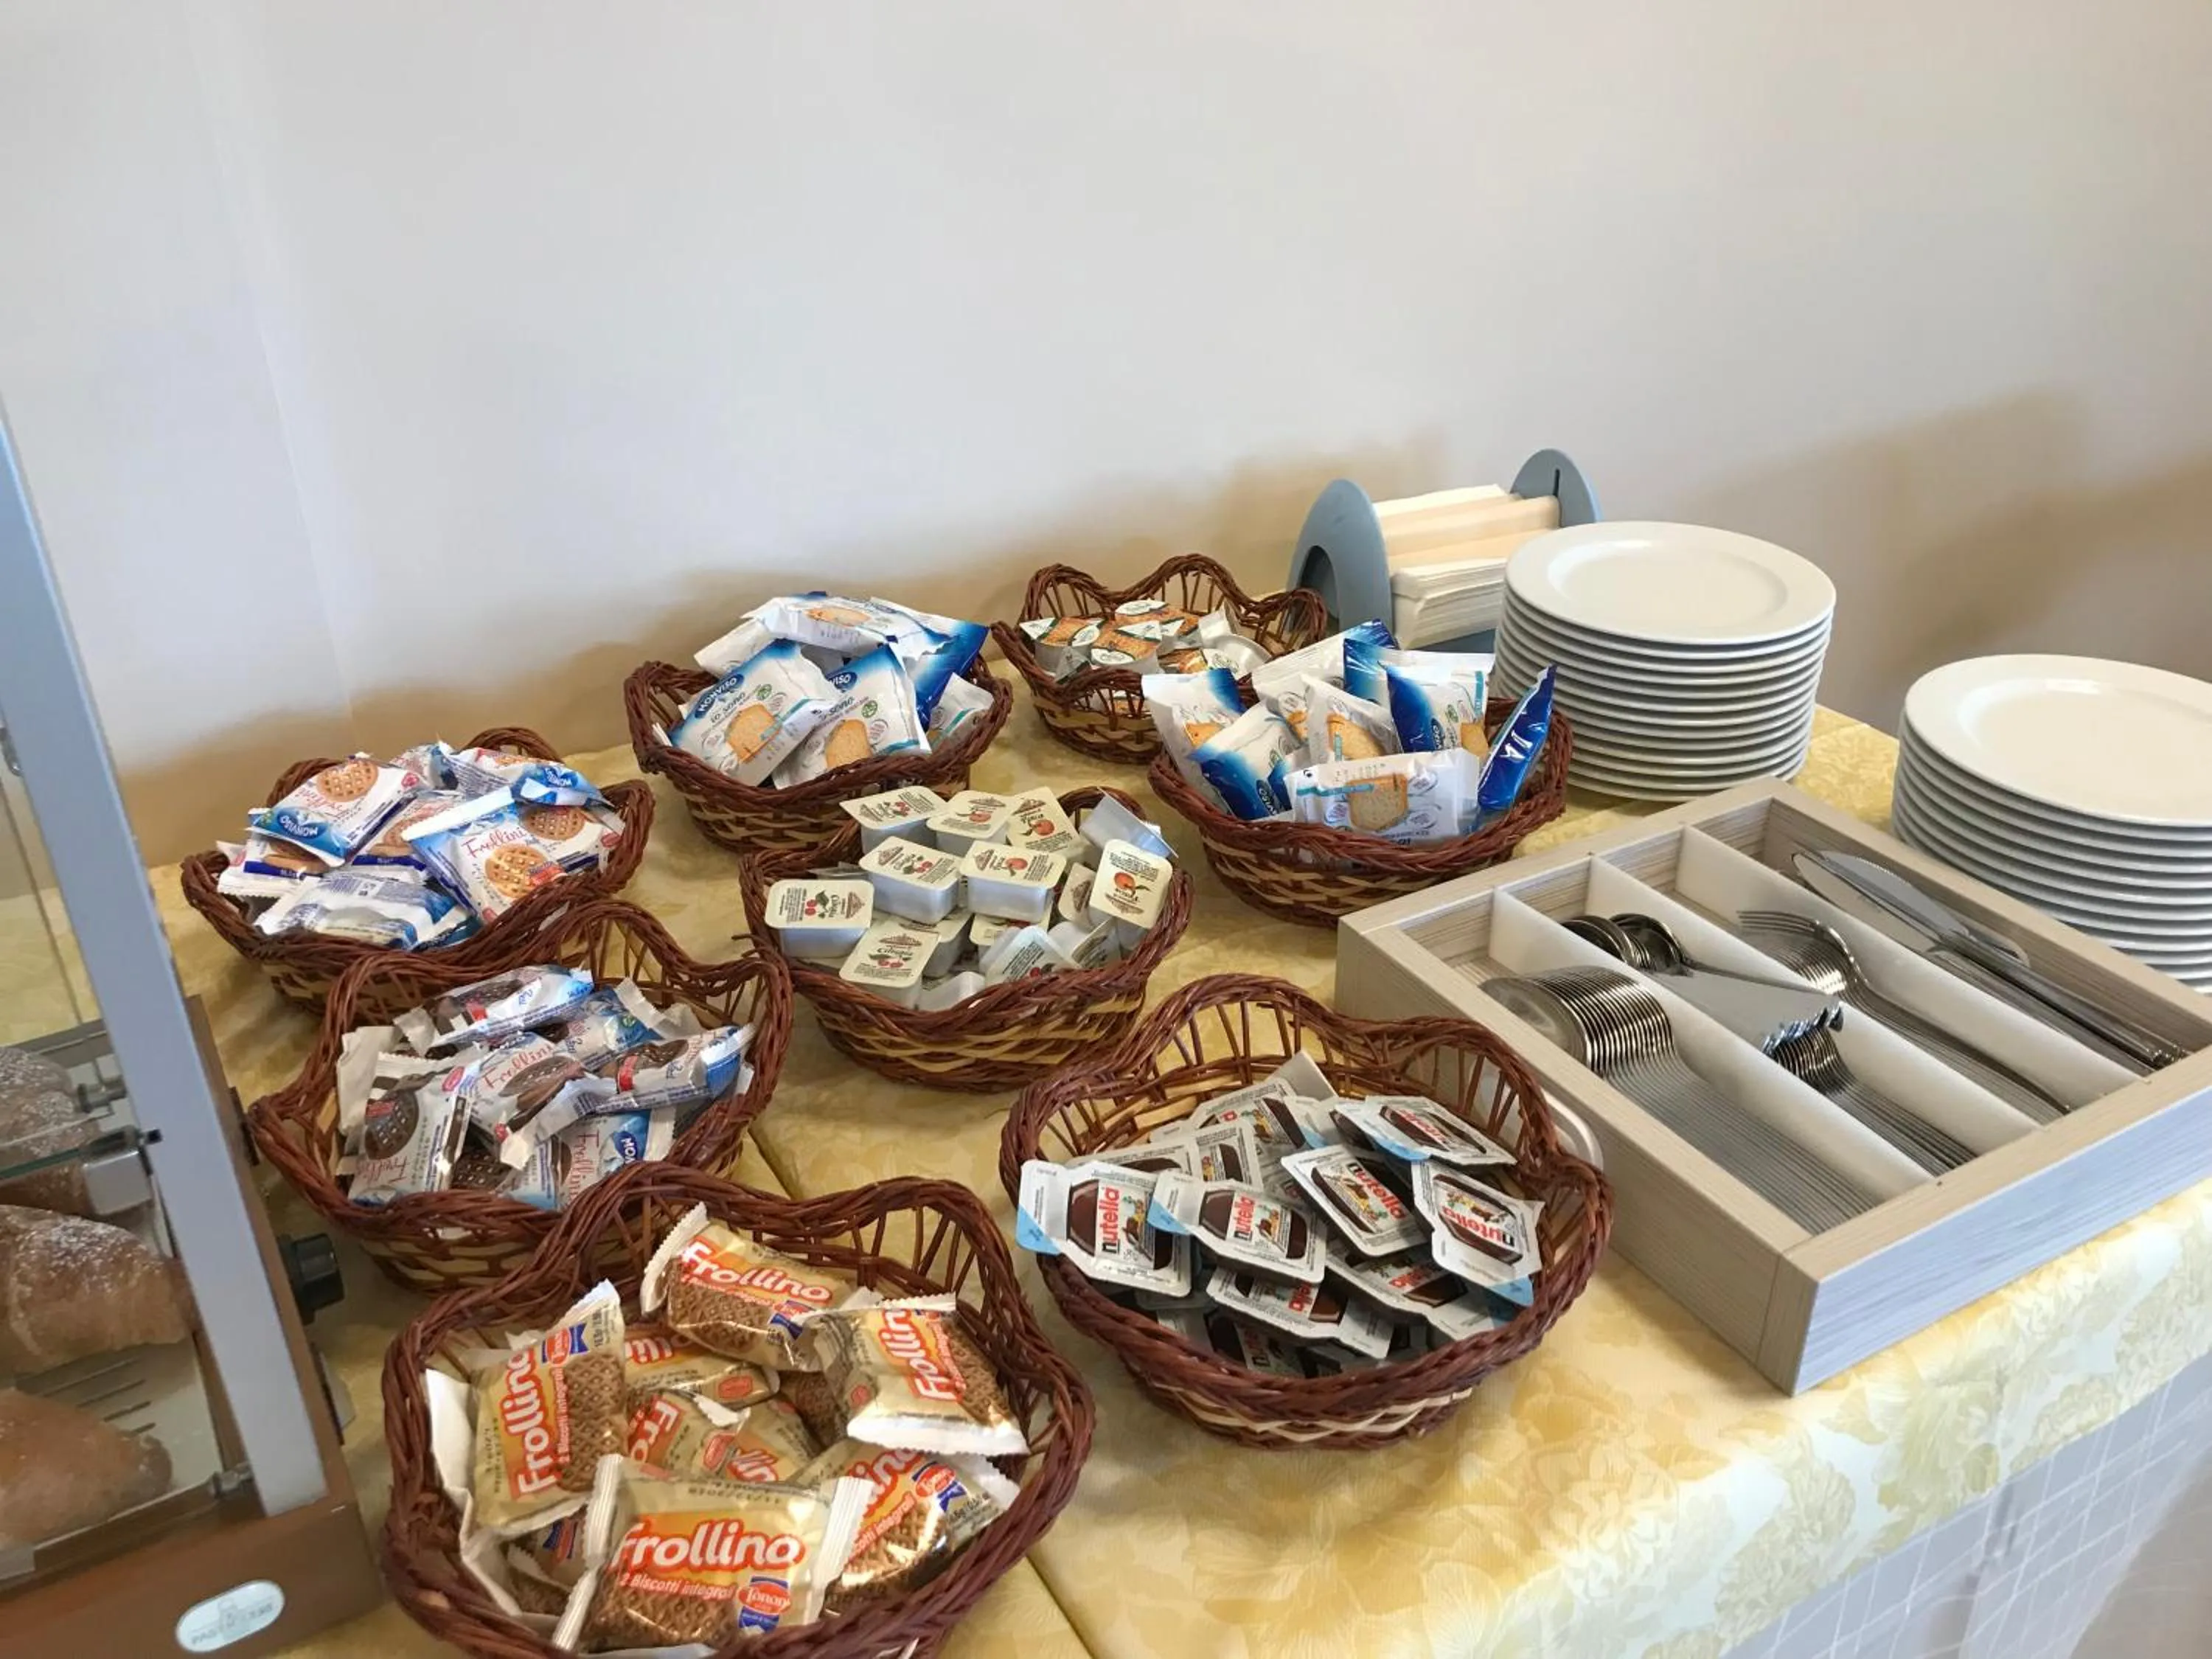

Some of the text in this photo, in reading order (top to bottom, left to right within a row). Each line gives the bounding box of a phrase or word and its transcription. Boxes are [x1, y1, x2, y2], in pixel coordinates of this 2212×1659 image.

[700, 677, 737, 712] MONVISO
[830, 674, 851, 686] VISO
[279, 814, 319, 837] MONVISO
[462, 827, 528, 858] Frollini
[482, 1043, 554, 1090] Frollini
[1346, 1162, 1406, 1221] nutella
[1098, 1186, 1120, 1254] nutella
[1234, 1195, 1255, 1241] nutella
[1442, 1206, 1515, 1248] nutella
[681, 1240, 832, 1301] Frollino
[880, 1310, 959, 1400] Frollin
[502, 1348, 557, 1494] Frollino
[610, 1521, 800, 1568] Frollino
[619, 1573, 631, 1586] 2
[631, 1574, 681, 1594] Biscotti
